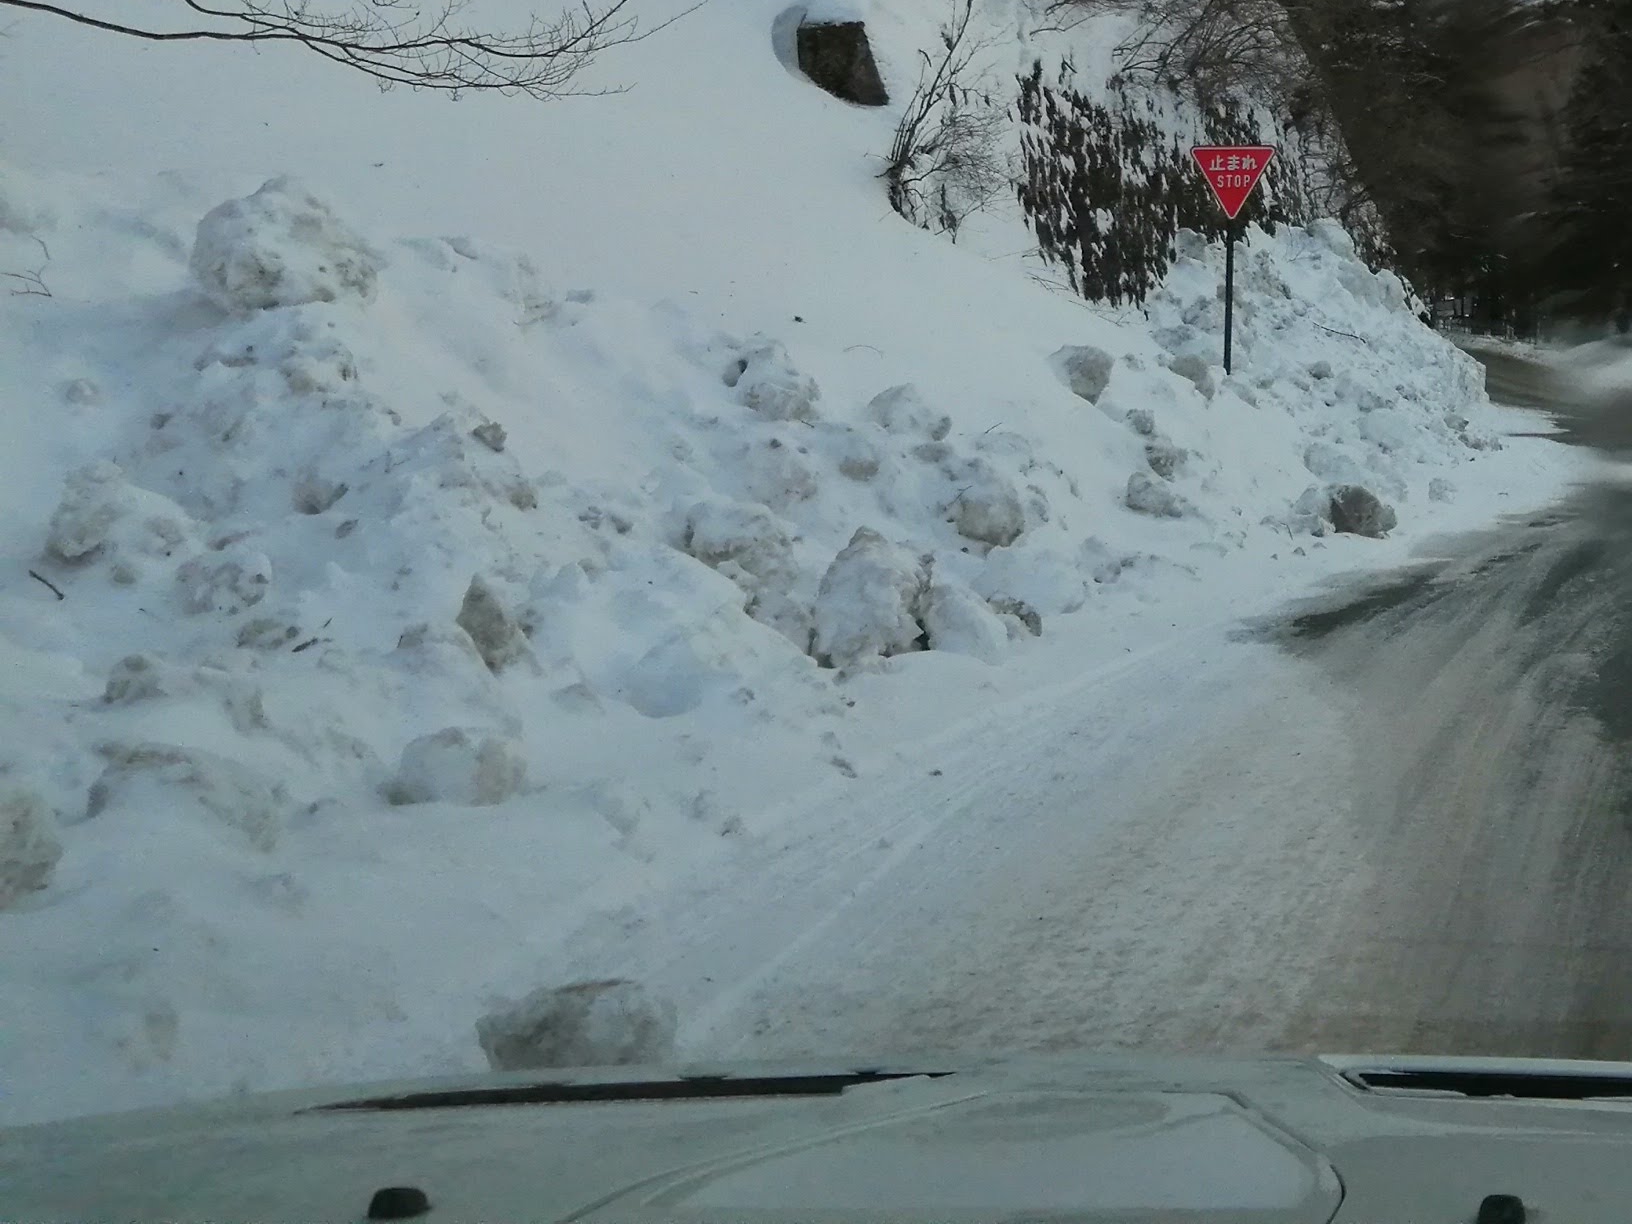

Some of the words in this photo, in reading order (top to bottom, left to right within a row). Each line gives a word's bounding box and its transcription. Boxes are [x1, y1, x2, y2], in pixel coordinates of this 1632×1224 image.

[1208, 154, 1258, 172] 止まれ
[1217, 174, 1251, 188] STOP
